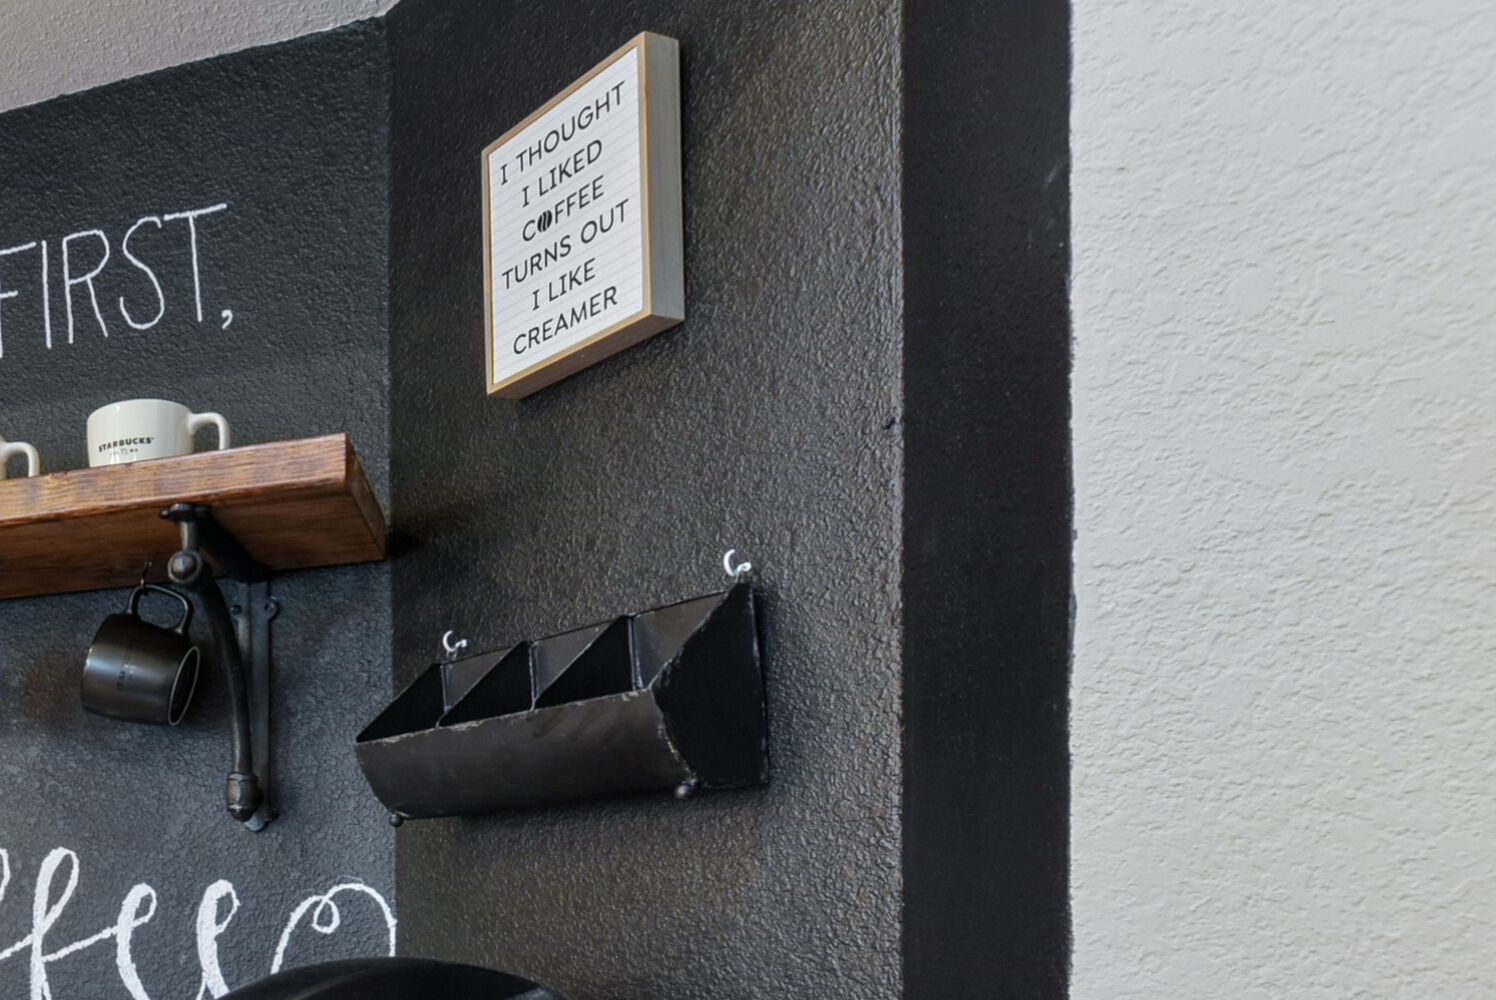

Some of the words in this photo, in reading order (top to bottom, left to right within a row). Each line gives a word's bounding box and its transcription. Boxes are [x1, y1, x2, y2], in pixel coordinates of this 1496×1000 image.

[500, 163, 509, 186] I
[515, 80, 625, 172] THOUGHT
[522, 185, 530, 208] I
[538, 139, 603, 197] LIKED
[501, 235, 572, 290] TURNS
[580, 198, 630, 245] OUT
[532, 289, 540, 312] I
[548, 257, 596, 302] LIKE
[513, 285, 618, 355] CREAMER
[98, 437, 153, 453] STARBUCKS
